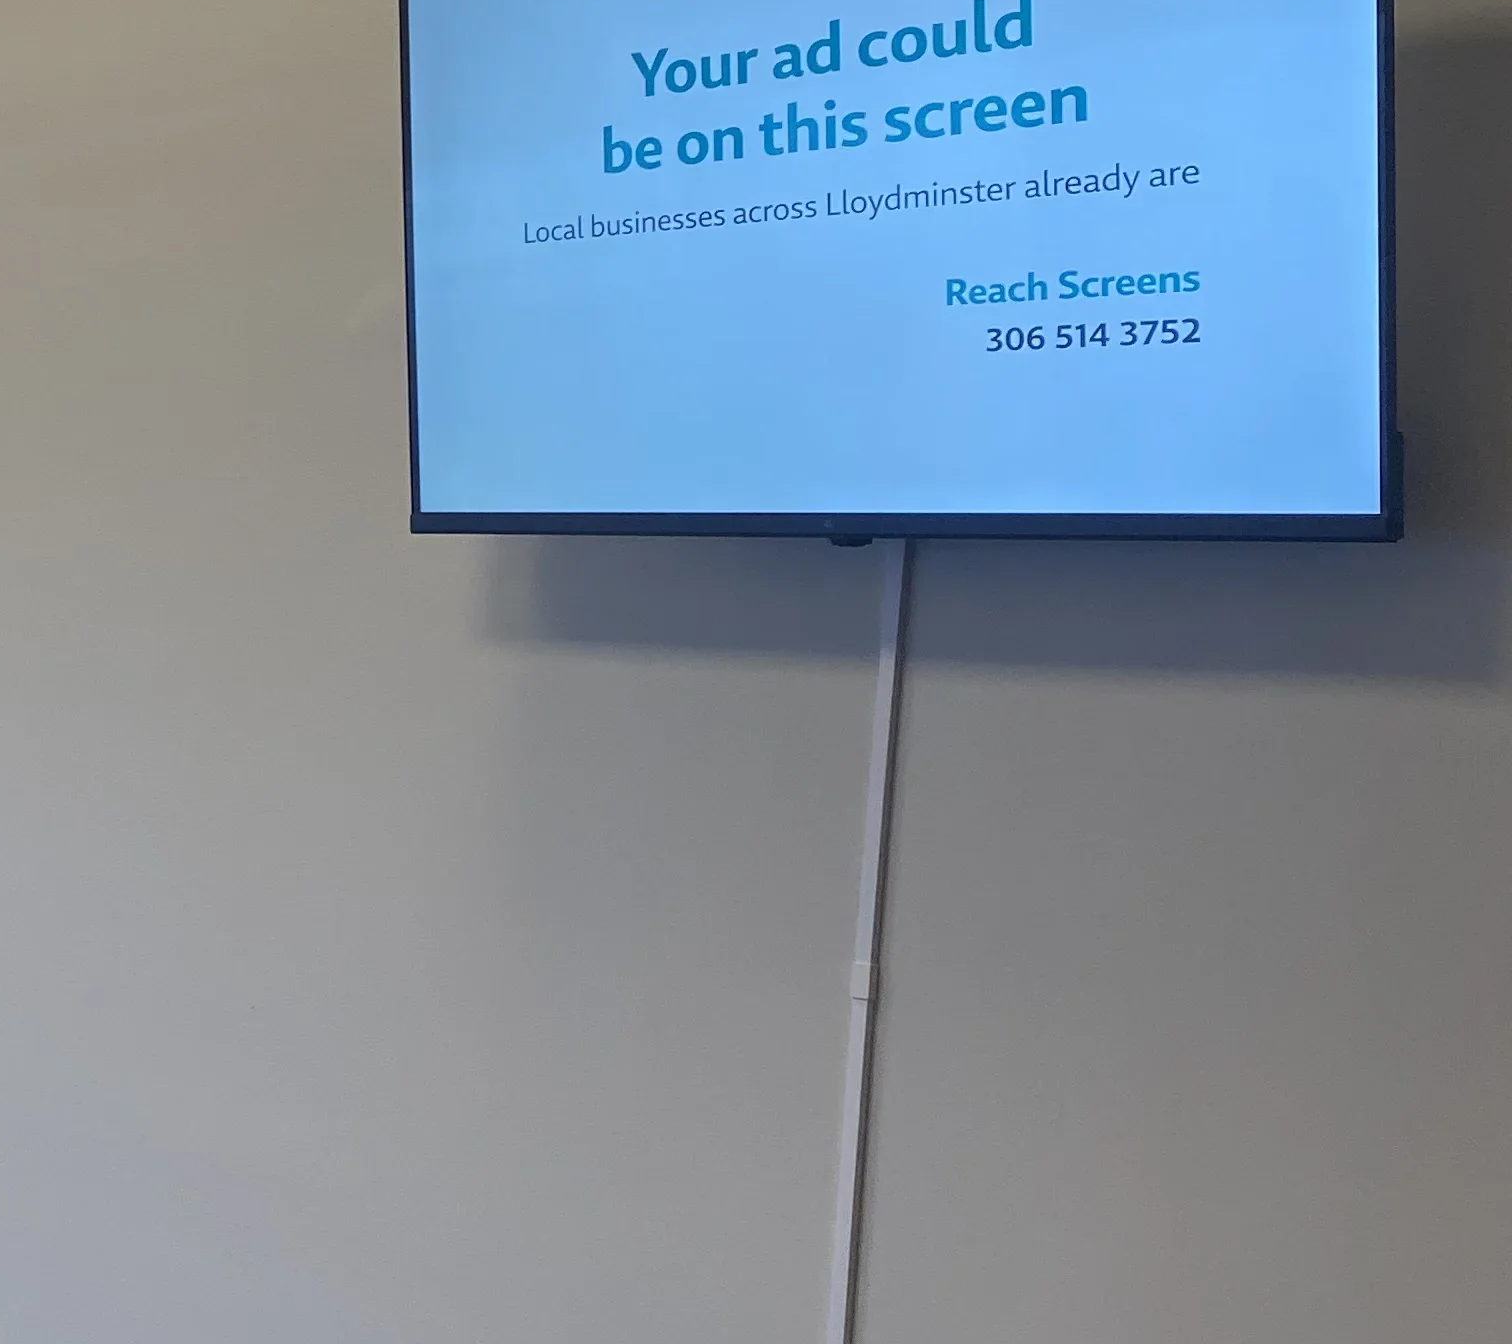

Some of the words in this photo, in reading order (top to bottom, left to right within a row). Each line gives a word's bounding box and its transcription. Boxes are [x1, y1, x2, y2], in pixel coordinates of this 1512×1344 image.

[630, 42, 759, 98] Your
[772, 18, 842, 80] ad
[602, 124, 663, 175] be
[676, 125, 745, 166] on
[757, 98, 869, 157] this
[883, 80, 1089, 143] screen
[523, 213, 585, 244] Local
[591, 206, 726, 239] businesses
[732, 197, 818, 226] across
[826, 178, 1017, 222] Lloydminster
[1024, 162, 1141, 201] already
[1149, 164, 1201, 189] are
[945, 271, 1050, 307] Reach
[1058, 266, 1201, 301] Screens
[985, 324, 1046, 353] 306
[1055, 322, 1111, 350] 514
[1119, 317, 1201, 347] 3752
